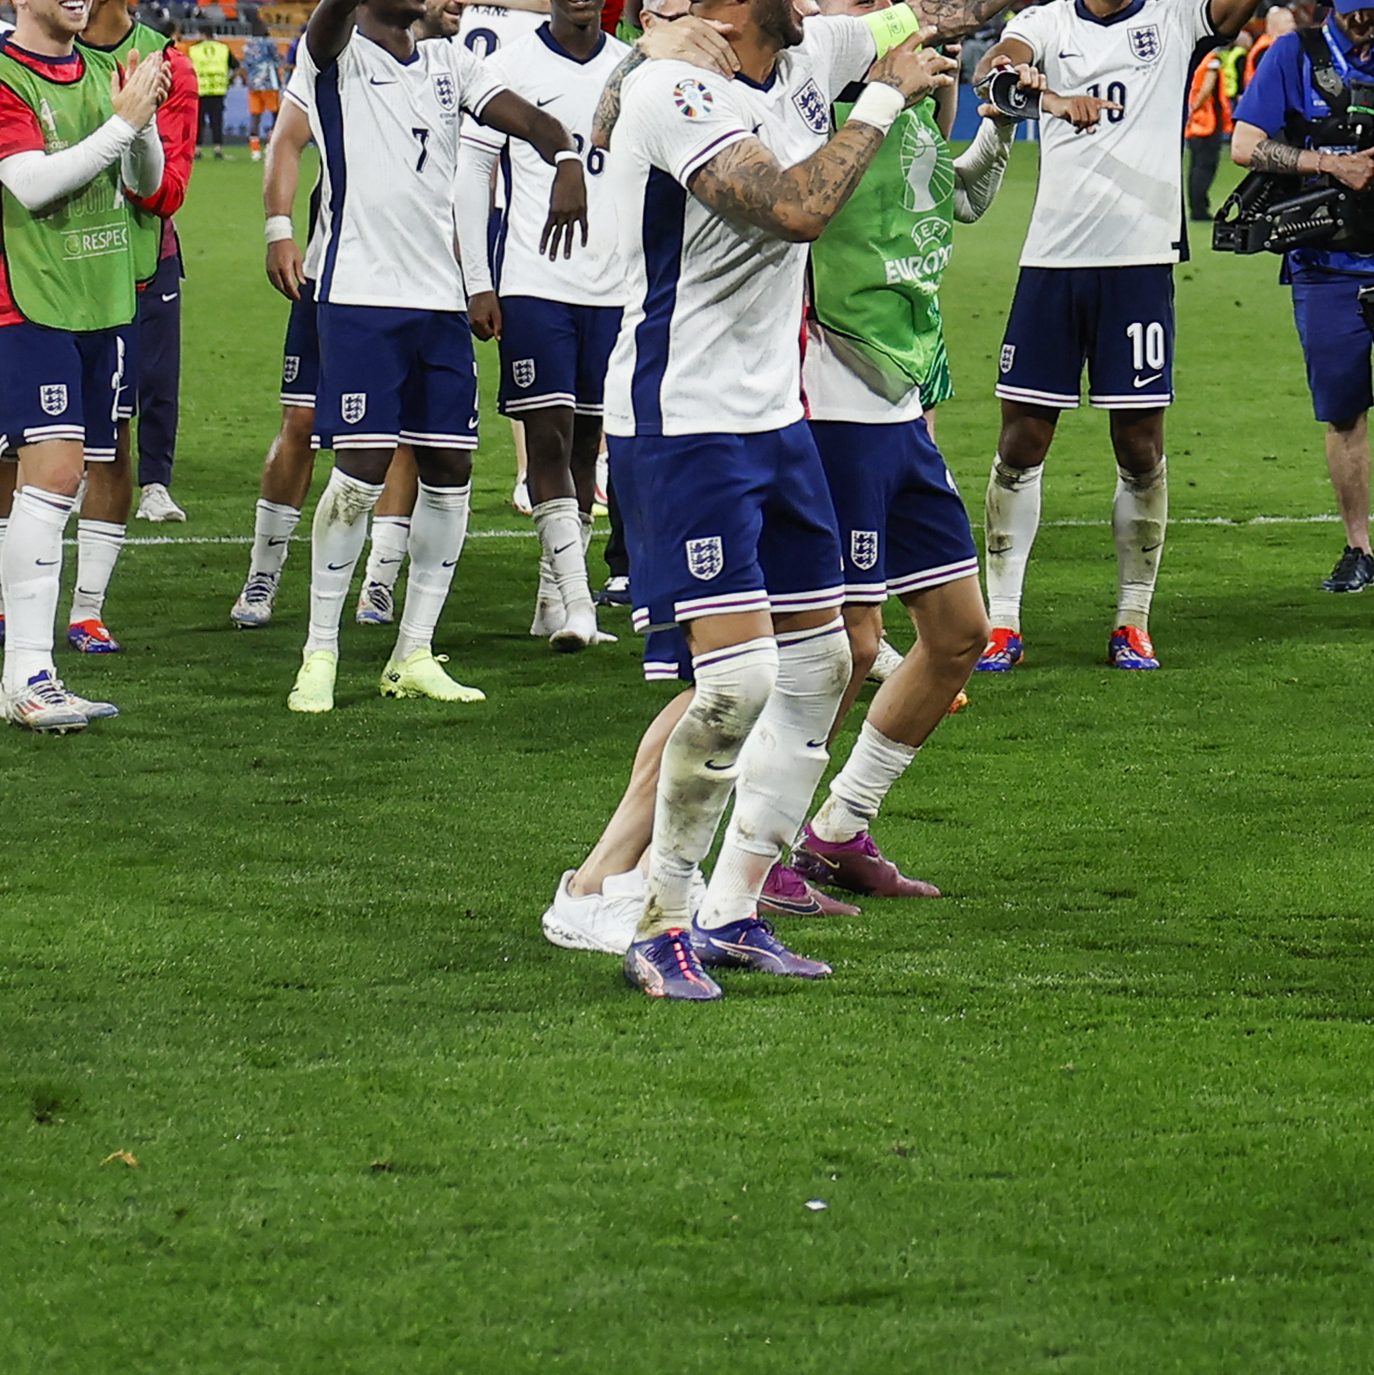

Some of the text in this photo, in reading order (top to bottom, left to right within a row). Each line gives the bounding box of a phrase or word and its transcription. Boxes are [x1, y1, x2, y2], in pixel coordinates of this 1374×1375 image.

[412, 128, 429, 174] 7
[913, 222, 948, 247] UEFA
[1127, 322, 1165, 370] 10
